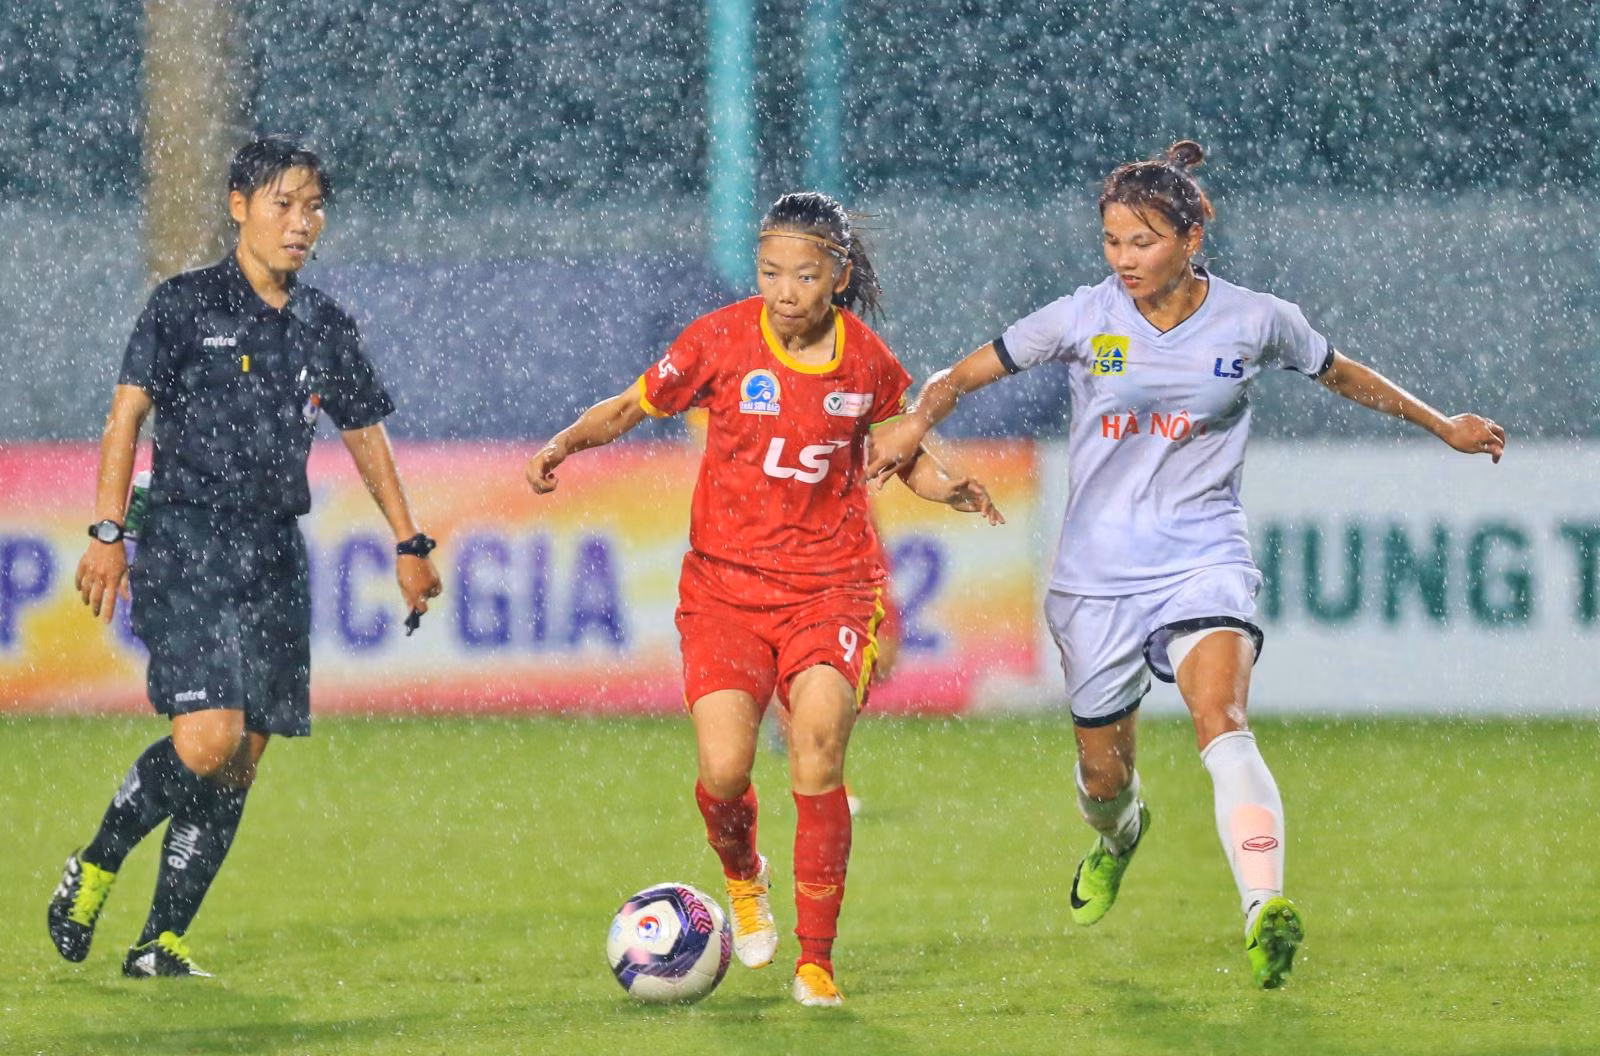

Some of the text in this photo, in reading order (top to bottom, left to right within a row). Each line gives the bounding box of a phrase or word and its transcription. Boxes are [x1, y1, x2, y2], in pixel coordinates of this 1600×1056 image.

[203, 336, 236, 347] mitre
[1214, 357, 1244, 379] LS
[1101, 409, 1140, 441] HÀ
[763, 437, 838, 484] LS
[455, 533, 625, 649] GIA
[838, 625, 858, 663] 9
[167, 823, 202, 870] mitre
